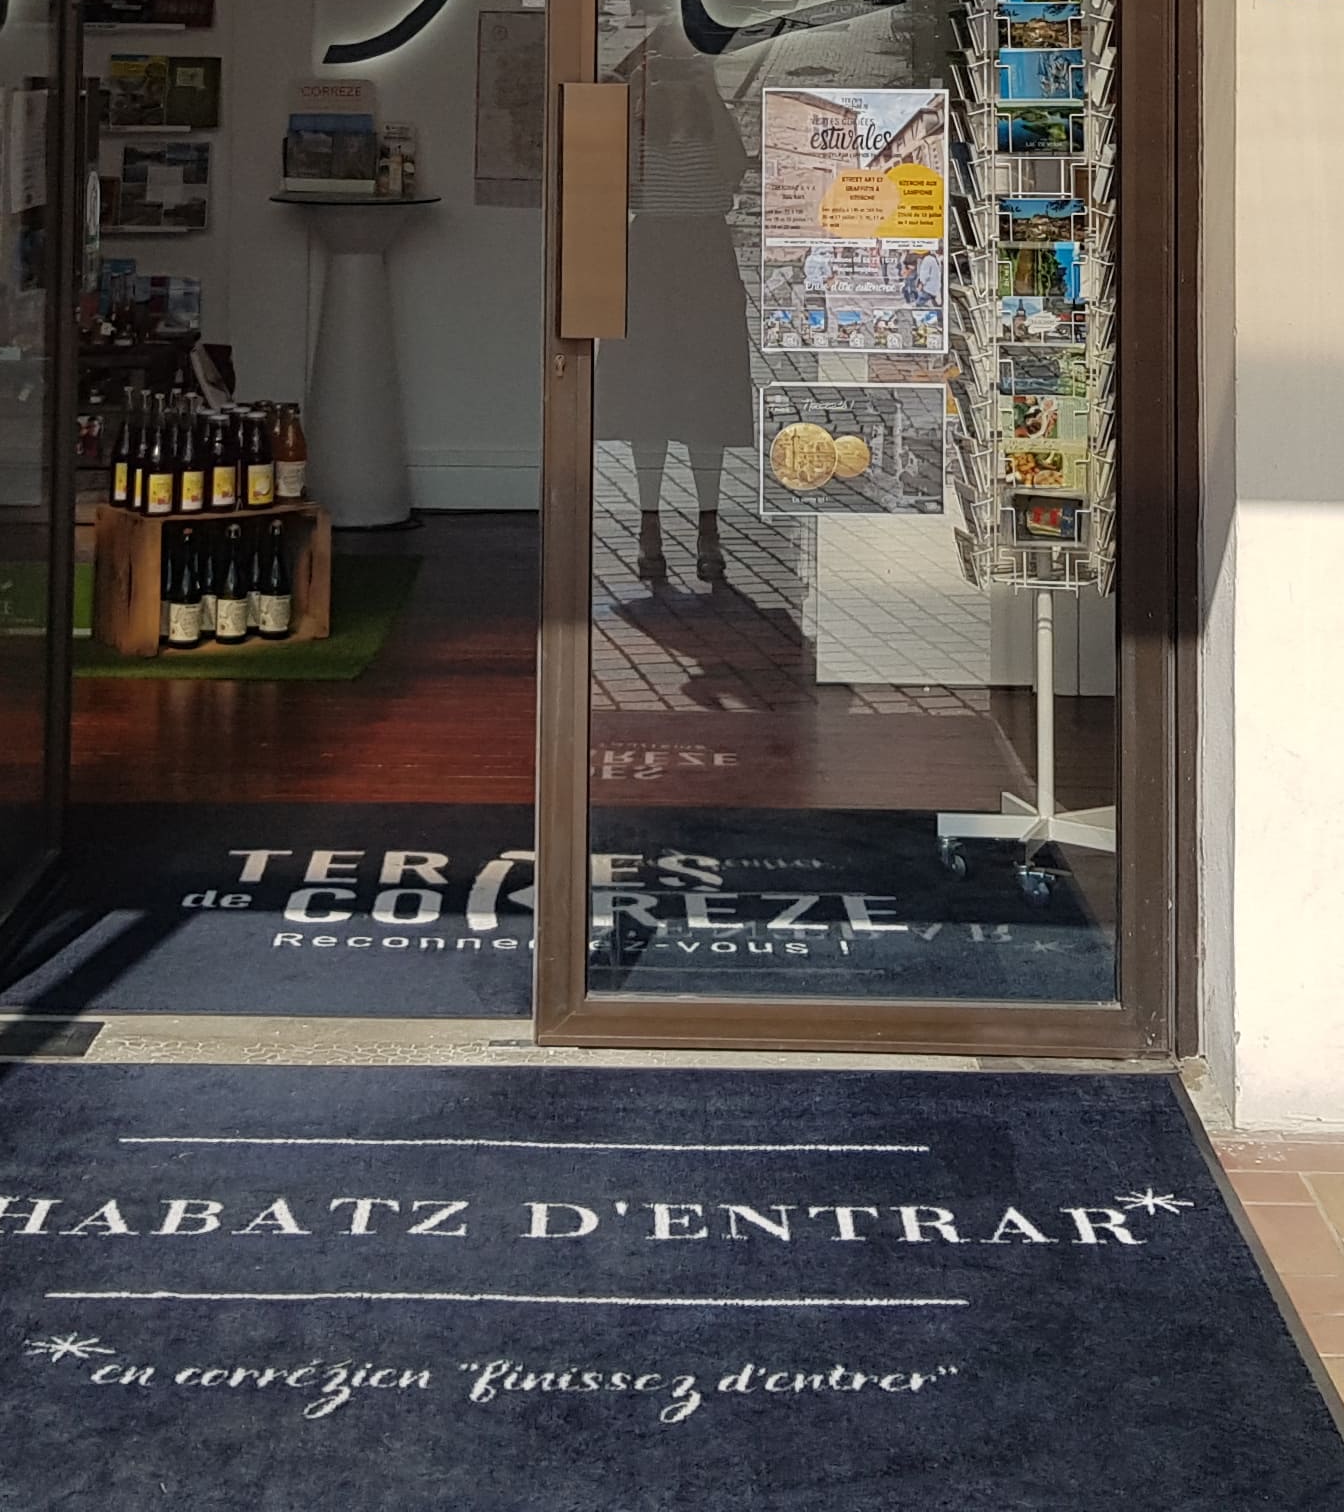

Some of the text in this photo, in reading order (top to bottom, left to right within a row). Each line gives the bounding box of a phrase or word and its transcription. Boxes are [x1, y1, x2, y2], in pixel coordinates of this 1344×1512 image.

[809, 124, 892, 151] estivales
[180, 889, 253, 909] de
[174, 1357, 431, 1419] corrézien
